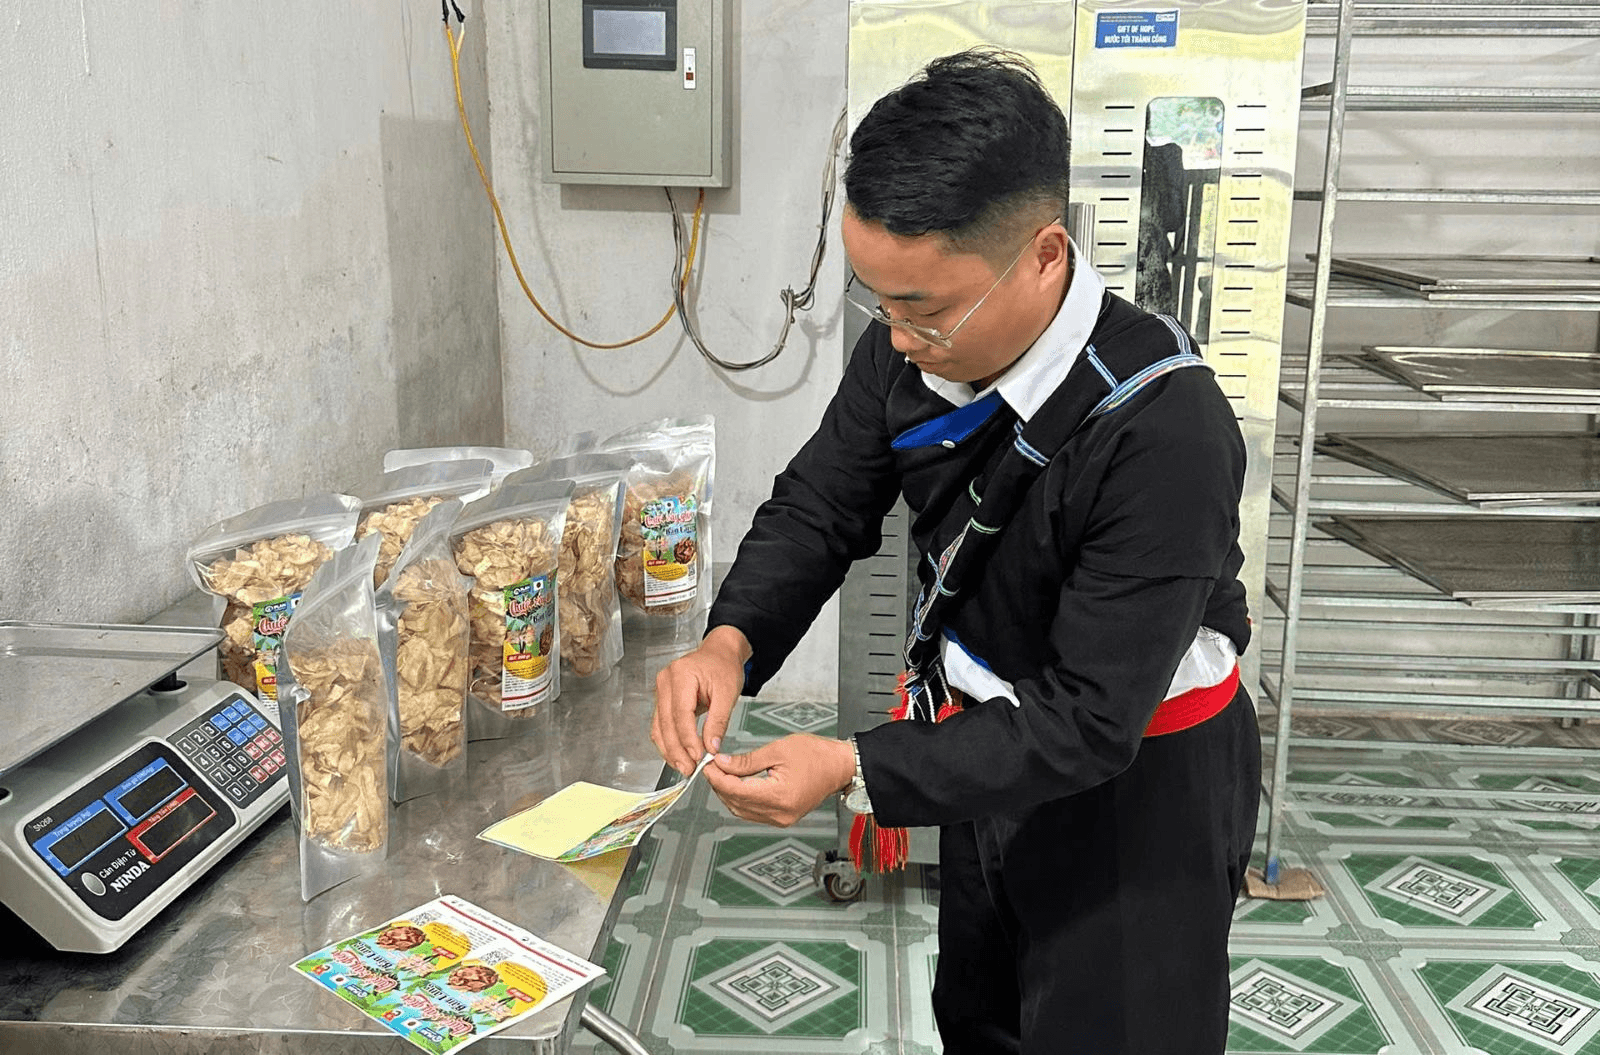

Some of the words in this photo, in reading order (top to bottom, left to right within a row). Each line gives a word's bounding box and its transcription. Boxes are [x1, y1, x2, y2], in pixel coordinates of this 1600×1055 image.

[1117, 25, 1130, 33] GIFT
[1130, 25, 1139, 33] OF
[1140, 24, 1156, 32] HOPE
[183, 742, 192, 750] 1
[194, 734, 204, 742] 2
[204, 726, 215, 734] 3
[200, 756, 209, 766] 4
[210, 748, 220, 758] 5
[222, 740, 232, 749] 6
[214, 772, 224, 781] 7
[226, 763, 236, 772] 8
[238, 754, 247, 764] 9
[232, 788, 242, 798] 0
